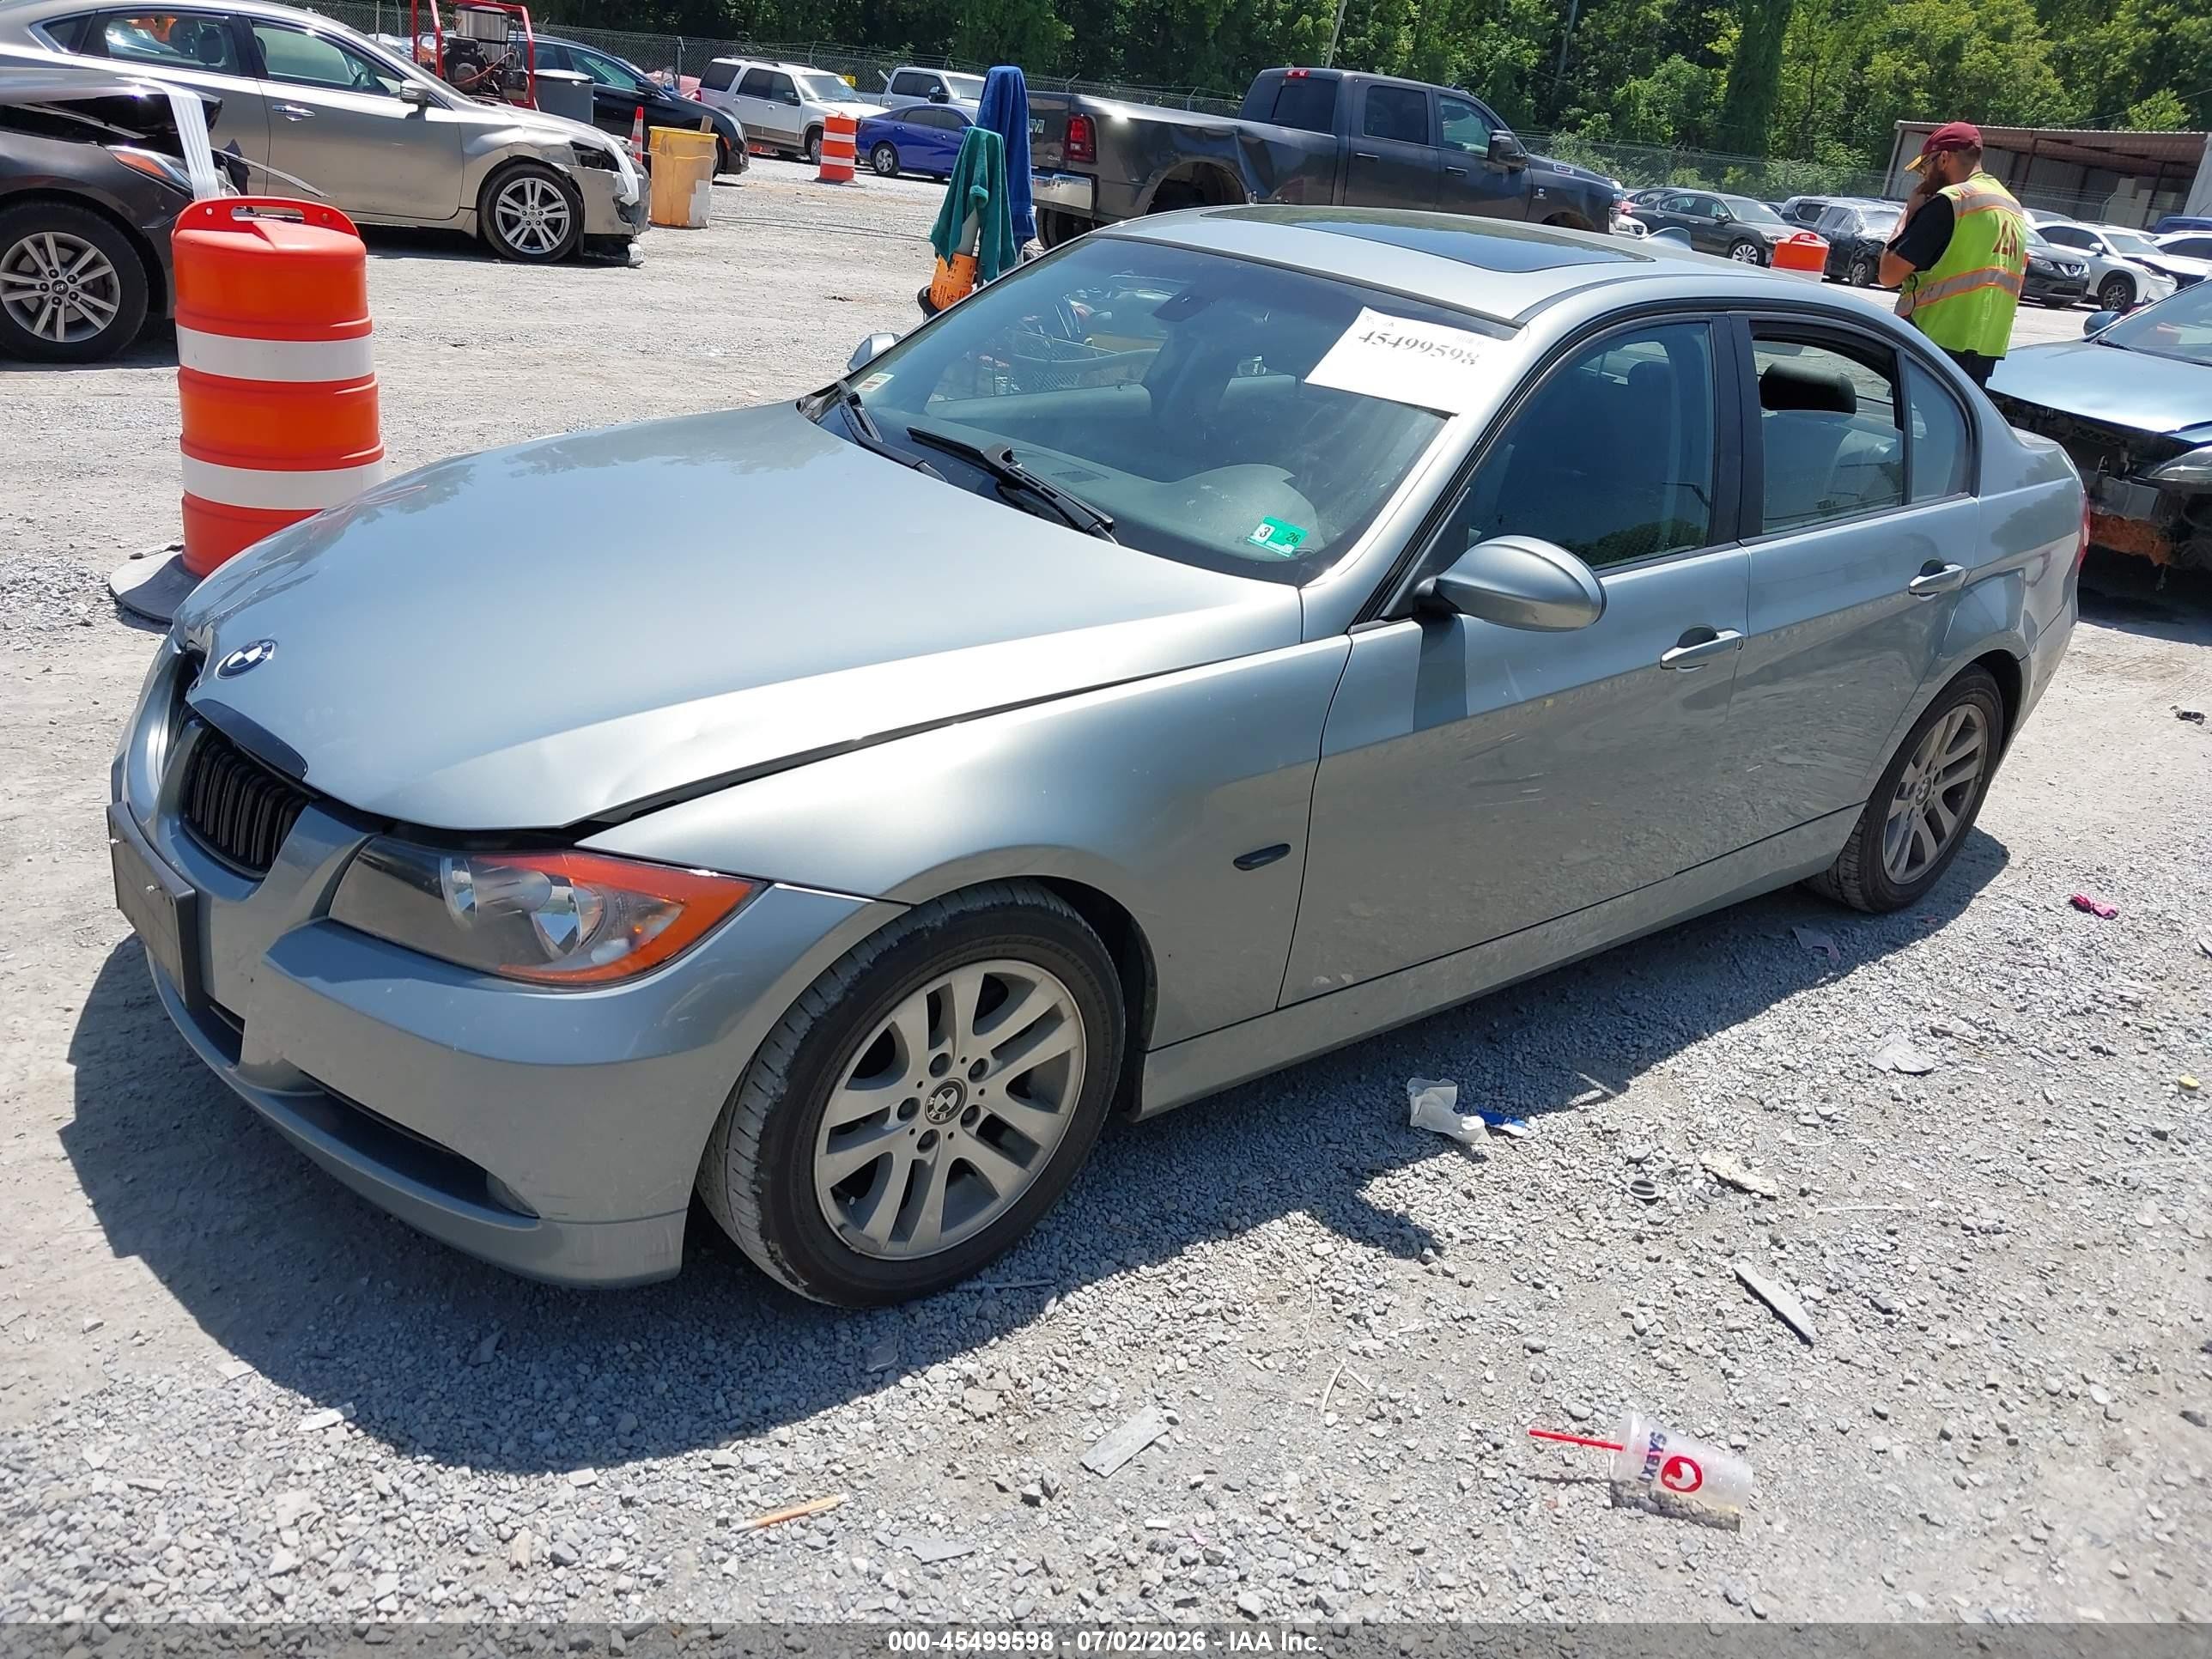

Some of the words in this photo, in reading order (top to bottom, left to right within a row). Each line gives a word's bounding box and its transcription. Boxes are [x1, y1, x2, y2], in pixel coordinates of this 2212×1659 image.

[1358, 330, 1480, 366] 45499598
[1259, 526, 1271, 538] 3
[1285, 532, 1302, 544] 26
